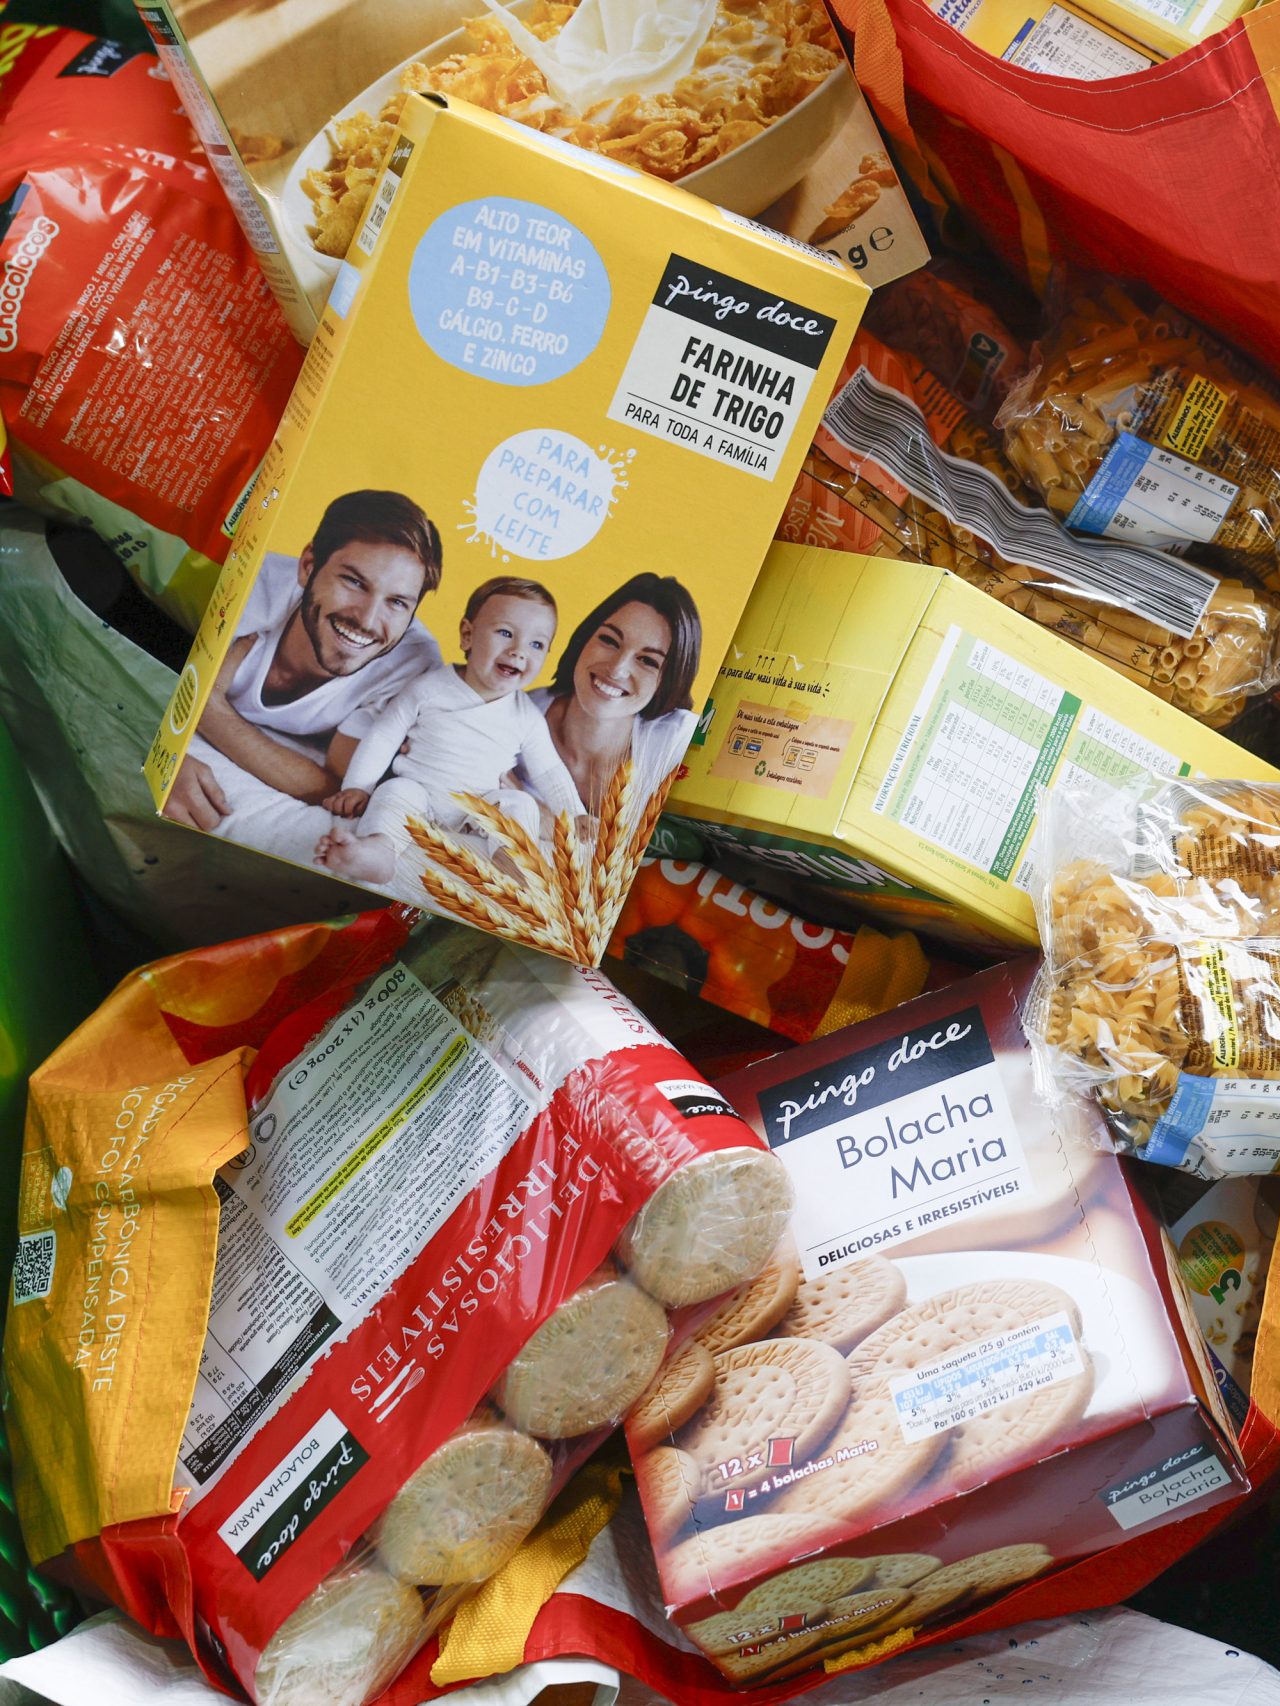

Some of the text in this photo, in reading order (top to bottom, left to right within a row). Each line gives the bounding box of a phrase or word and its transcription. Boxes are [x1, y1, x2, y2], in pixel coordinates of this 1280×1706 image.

[451, 225, 585, 280] EM VITAMINAS
[473, 203, 571, 250] ALTO TEOR
[49, 382, 64, 402] AND
[59, 356, 79, 383] CORN
[91, 304, 108, 326] WITH
[103, 292, 115, 305] 10
[110, 258, 135, 295] VITAMINS
[130, 243, 145, 260] AND
[439, 309, 569, 355] CÁLCIO, FERRO
[669, 274, 823, 336] pingo doce
[32, 376, 44, 388] DE
[40, 349, 60, 375] TRIGO
[76, 282, 96, 307] TRIGO
[41, 278, 111, 393] VITAMINAS FERRO COCOA
[462, 341, 537, 377] E ZINCO
[680, 335, 795, 406] FARINHA
[669, 372, 706, 409] DE
[712, 391, 783, 440] TRIGO
[536, 436, 590, 478] PARA
[624, 402, 768, 471] PARA TODA A FAMÍLIA
[499, 448, 603, 517] PREPARAR
[511, 492, 560, 528] COM
[494, 513, 552, 555] LEITE
[894, 713, 921, 762] NUTRICIONAL
[305, 1031, 345, 1073] 200g
[776, 1020, 972, 1138] pingo doce
[95, 1135, 125, 1174] FOI
[837, 1088, 994, 1169] Bolacha
[438, 1176, 468, 1207] MARIA
[890, 1135, 1008, 1199] Maria
[106, 1156, 144, 1306] CARBÓNICA
[409, 1206, 444, 1242] BISCUIT
[818, 1180, 1020, 1267] DELICIOSAS E IRRESISTÍVEIS!
[73, 1182, 110, 1370] COMPENSADA!
[346, 1130, 580, 1404] E IRRESISTÍVEIS
[376, 1244, 410, 1280] BISCUIT
[423, 1153, 602, 1362] DELICIOSAS
[348, 1277, 380, 1310] MARIA
[90, 1309, 127, 1394] DESTE
[916, 1365, 940, 1380] Uma
[939, 1348, 978, 1371] saqueta
[977, 1340, 994, 1356] (25
[1005, 1322, 1041, 1342] contém
[933, 1417, 949, 1430] Por
[950, 1410, 967, 1422] 100
[977, 1395, 997, 1410] 1812
[1016, 1380, 1034, 1393] 429
[1035, 1371, 1054, 1385] kcal
[227, 1437, 320, 1539] BOLACHA MARIA
[717, 1452, 764, 1479] 12 x
[759, 1438, 880, 1493] 4 bolachas Maria
[1105, 1444, 1205, 1503] pingo doce
[1138, 1462, 1215, 1503] Bolacha
[1166, 1473, 1223, 1506] Maria
[255, 1443, 354, 1569] pingo doce
[788, 1597, 894, 1639] bolachas Maria
